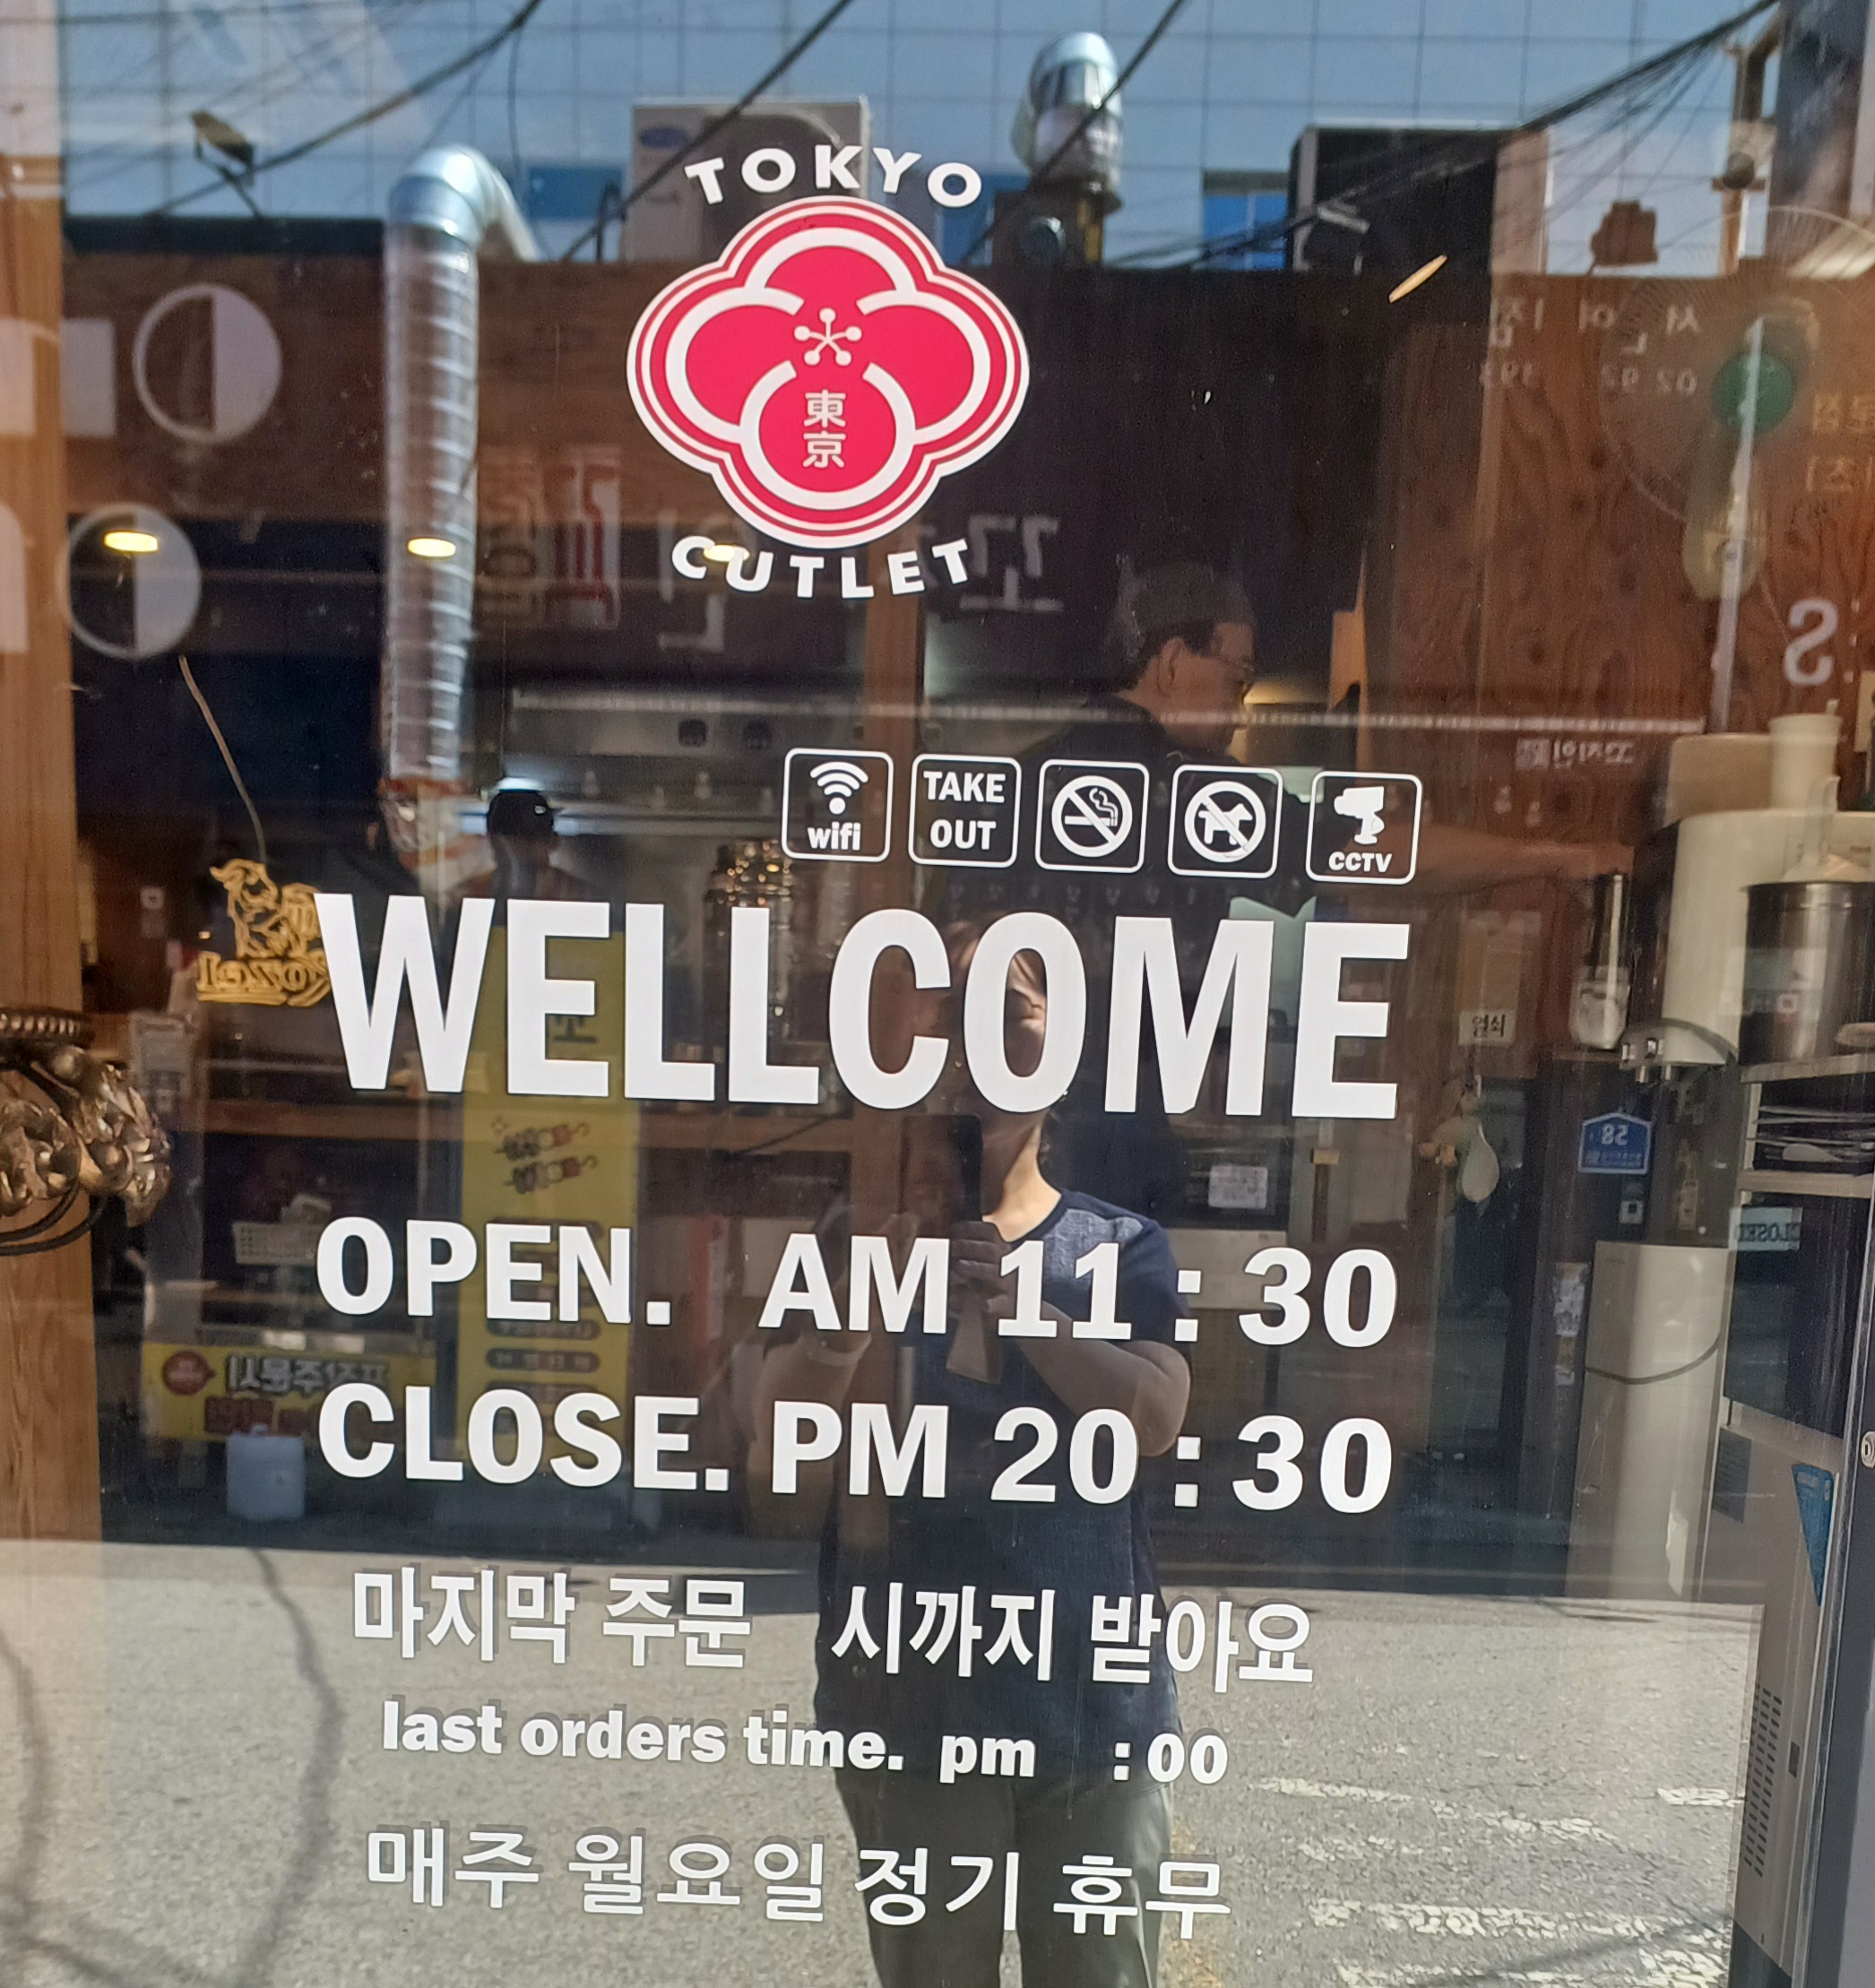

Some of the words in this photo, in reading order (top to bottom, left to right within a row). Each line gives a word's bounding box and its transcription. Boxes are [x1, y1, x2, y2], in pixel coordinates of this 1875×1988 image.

[685, 144, 982, 208] TOKYO
[802, 389, 847, 469] 東京
[672, 535, 969, 599] CUTLET
[923, 770, 1007, 804] TAKE
[808, 821, 861, 851] wifi
[929, 819, 997, 851] OUT
[1327, 851, 1394, 874] CCTV
[313, 893, 1412, 1120] WELLCOME
[316, 1216, 671, 1326] OPEN.
[757, 1233, 951, 1335] AM
[318, 1382, 729, 1492] CLOSE.
[772, 1401, 949, 1499] PM
[354, 1569, 575, 1664] 마지막
[603, 1578, 750, 1668] 주문
[831, 1582, 1055, 1681] 시까지
[1091, 1594, 1313, 1693] 받아요
[383, 1700, 502, 1755] last
[521, 1710, 726, 1763] orders
[743, 1710, 903, 1770] time.
[940, 1735, 1036, 1785] pm
[368, 1828, 540, 1908] 매주
[568, 1835, 825, 1922] 월요일
[854, 1848, 1020, 1931] 정기
[1053, 1855, 1231, 1940] 휴무
